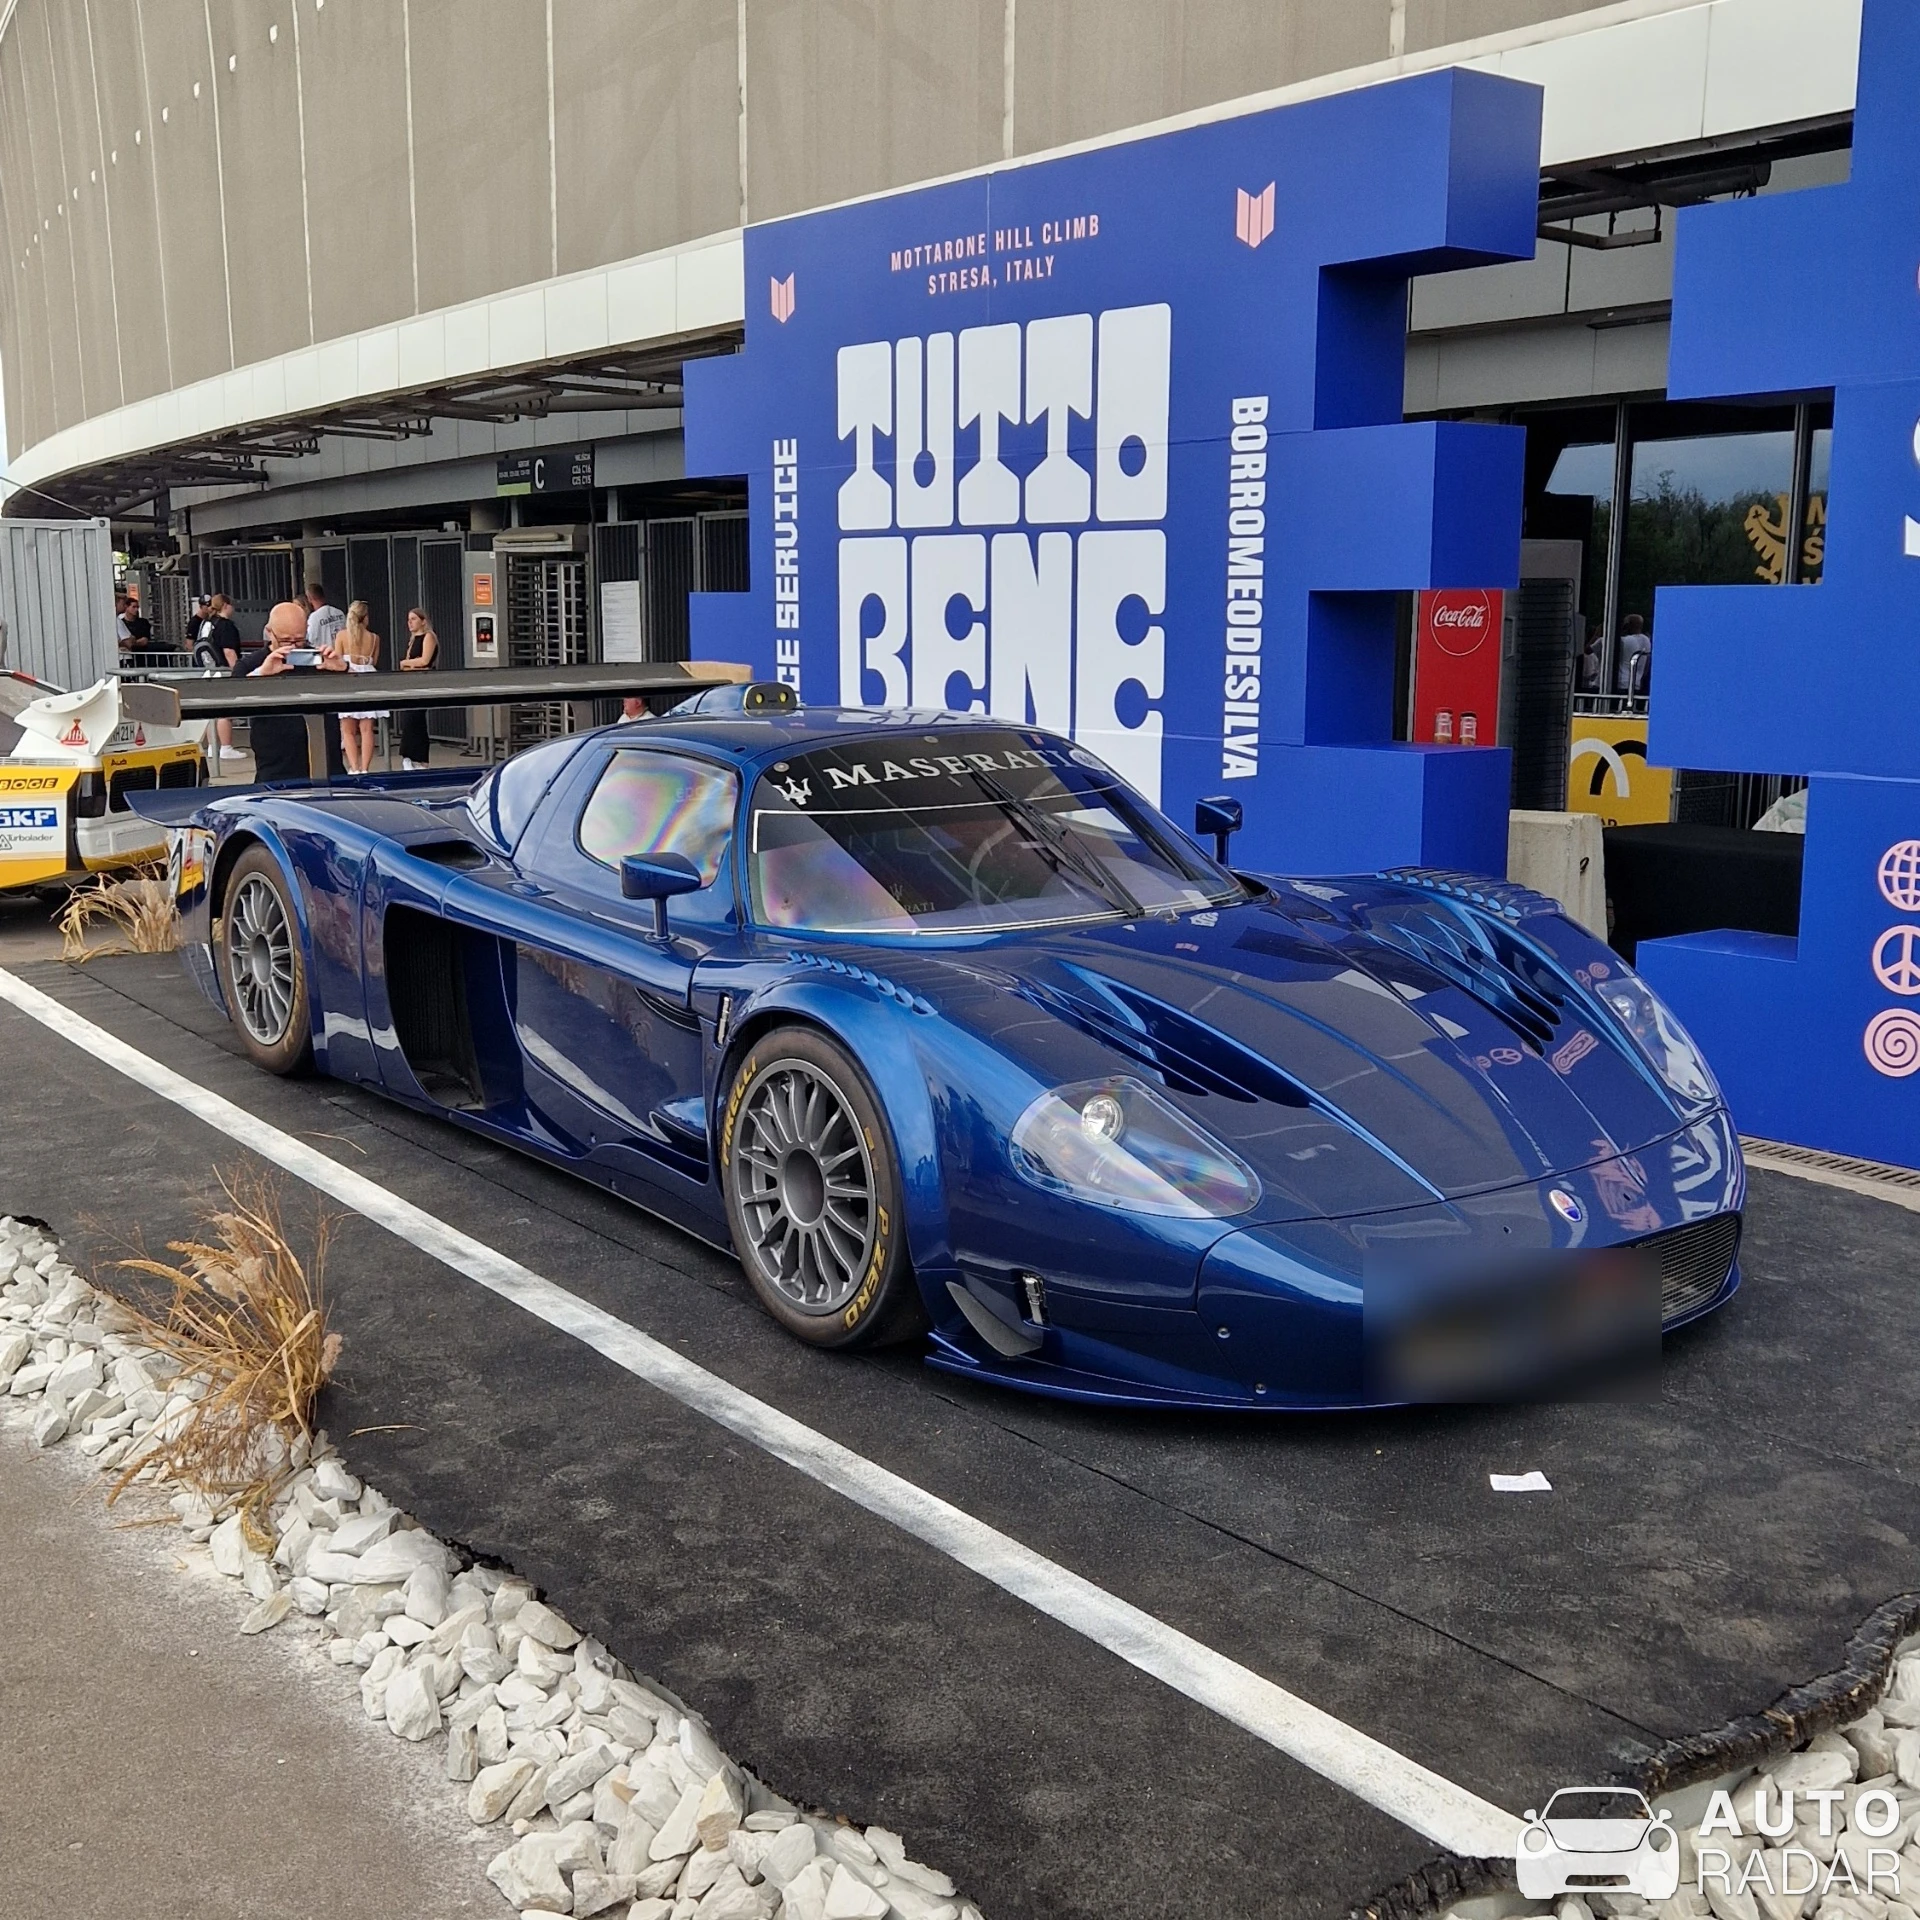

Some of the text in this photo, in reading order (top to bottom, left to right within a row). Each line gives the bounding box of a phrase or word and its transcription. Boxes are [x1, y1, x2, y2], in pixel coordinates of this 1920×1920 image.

[890, 214, 1099, 272] MOTTARONE HILL CLIMB
[928, 254, 1055, 295] STRESA, ITALY
[837, 303, 1172, 531] TUTTO
[534, 458, 545, 490] C
[1222, 396, 1269, 779] BORROMEODESILVA
[0, 779, 57, 790] BOGE
[823, 748, 1078, 790] MASERATI
[0, 810, 55, 826] SKF
[7, 833, 54, 841] Turbolader
[721, 1056, 757, 1166] PIRELLI
